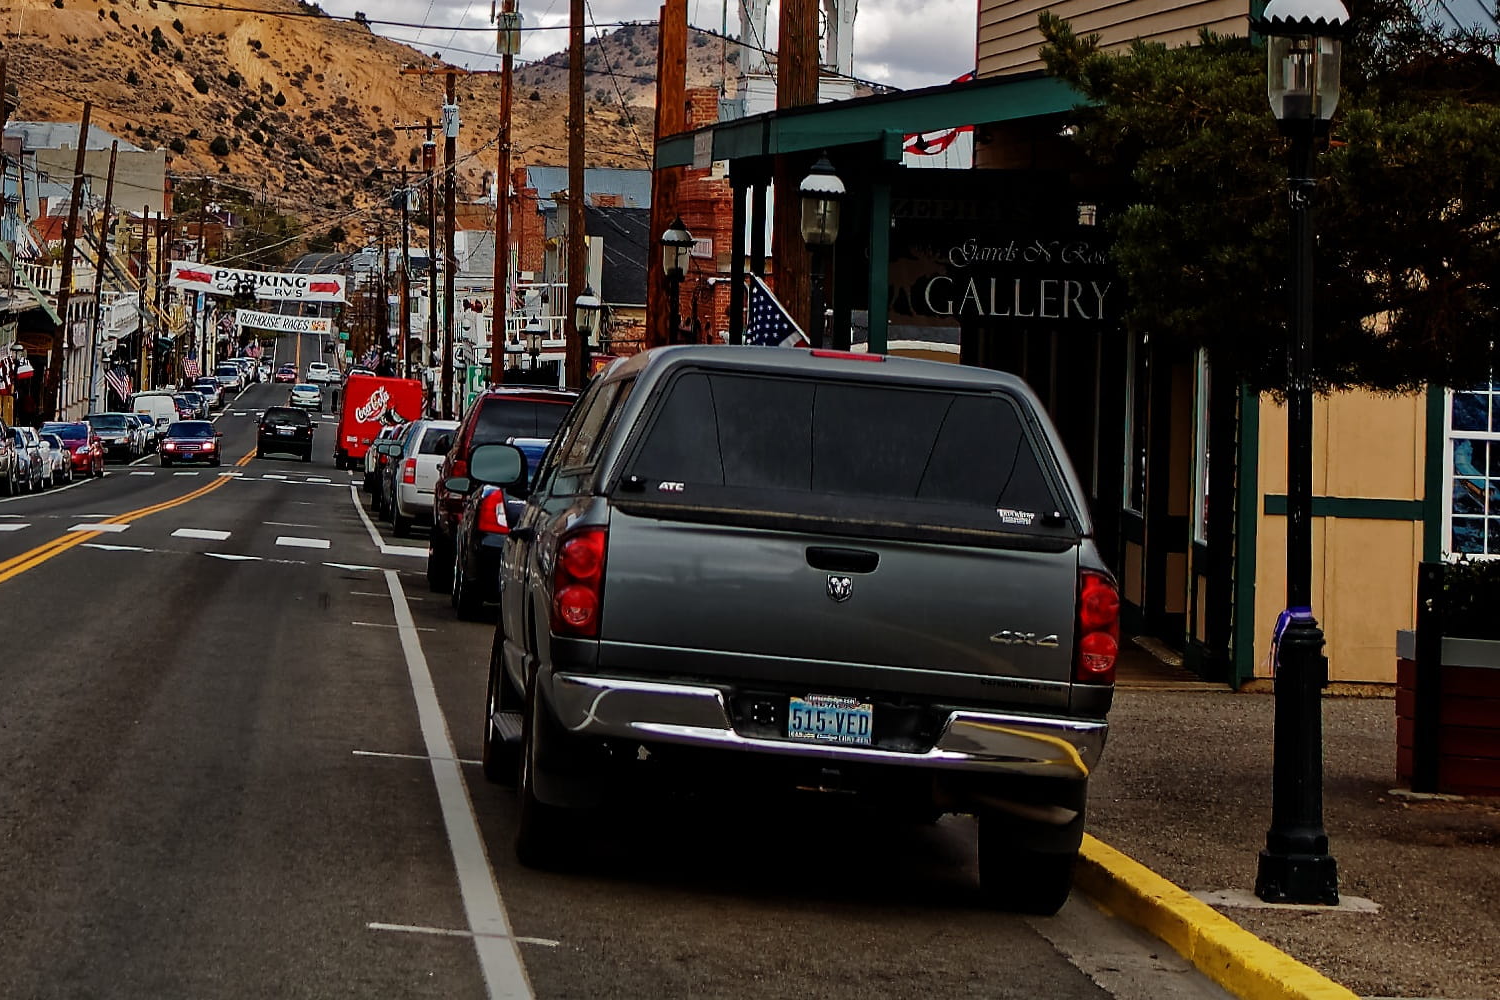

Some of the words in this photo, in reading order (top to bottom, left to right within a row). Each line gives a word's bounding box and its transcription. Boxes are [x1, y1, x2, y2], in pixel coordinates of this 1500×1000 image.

[215, 270, 307, 289] PARKING
[924, 275, 1112, 320] GALLERY
[240, 311, 280, 328] OUTHOUSE
[658, 481, 685, 491] ATC
